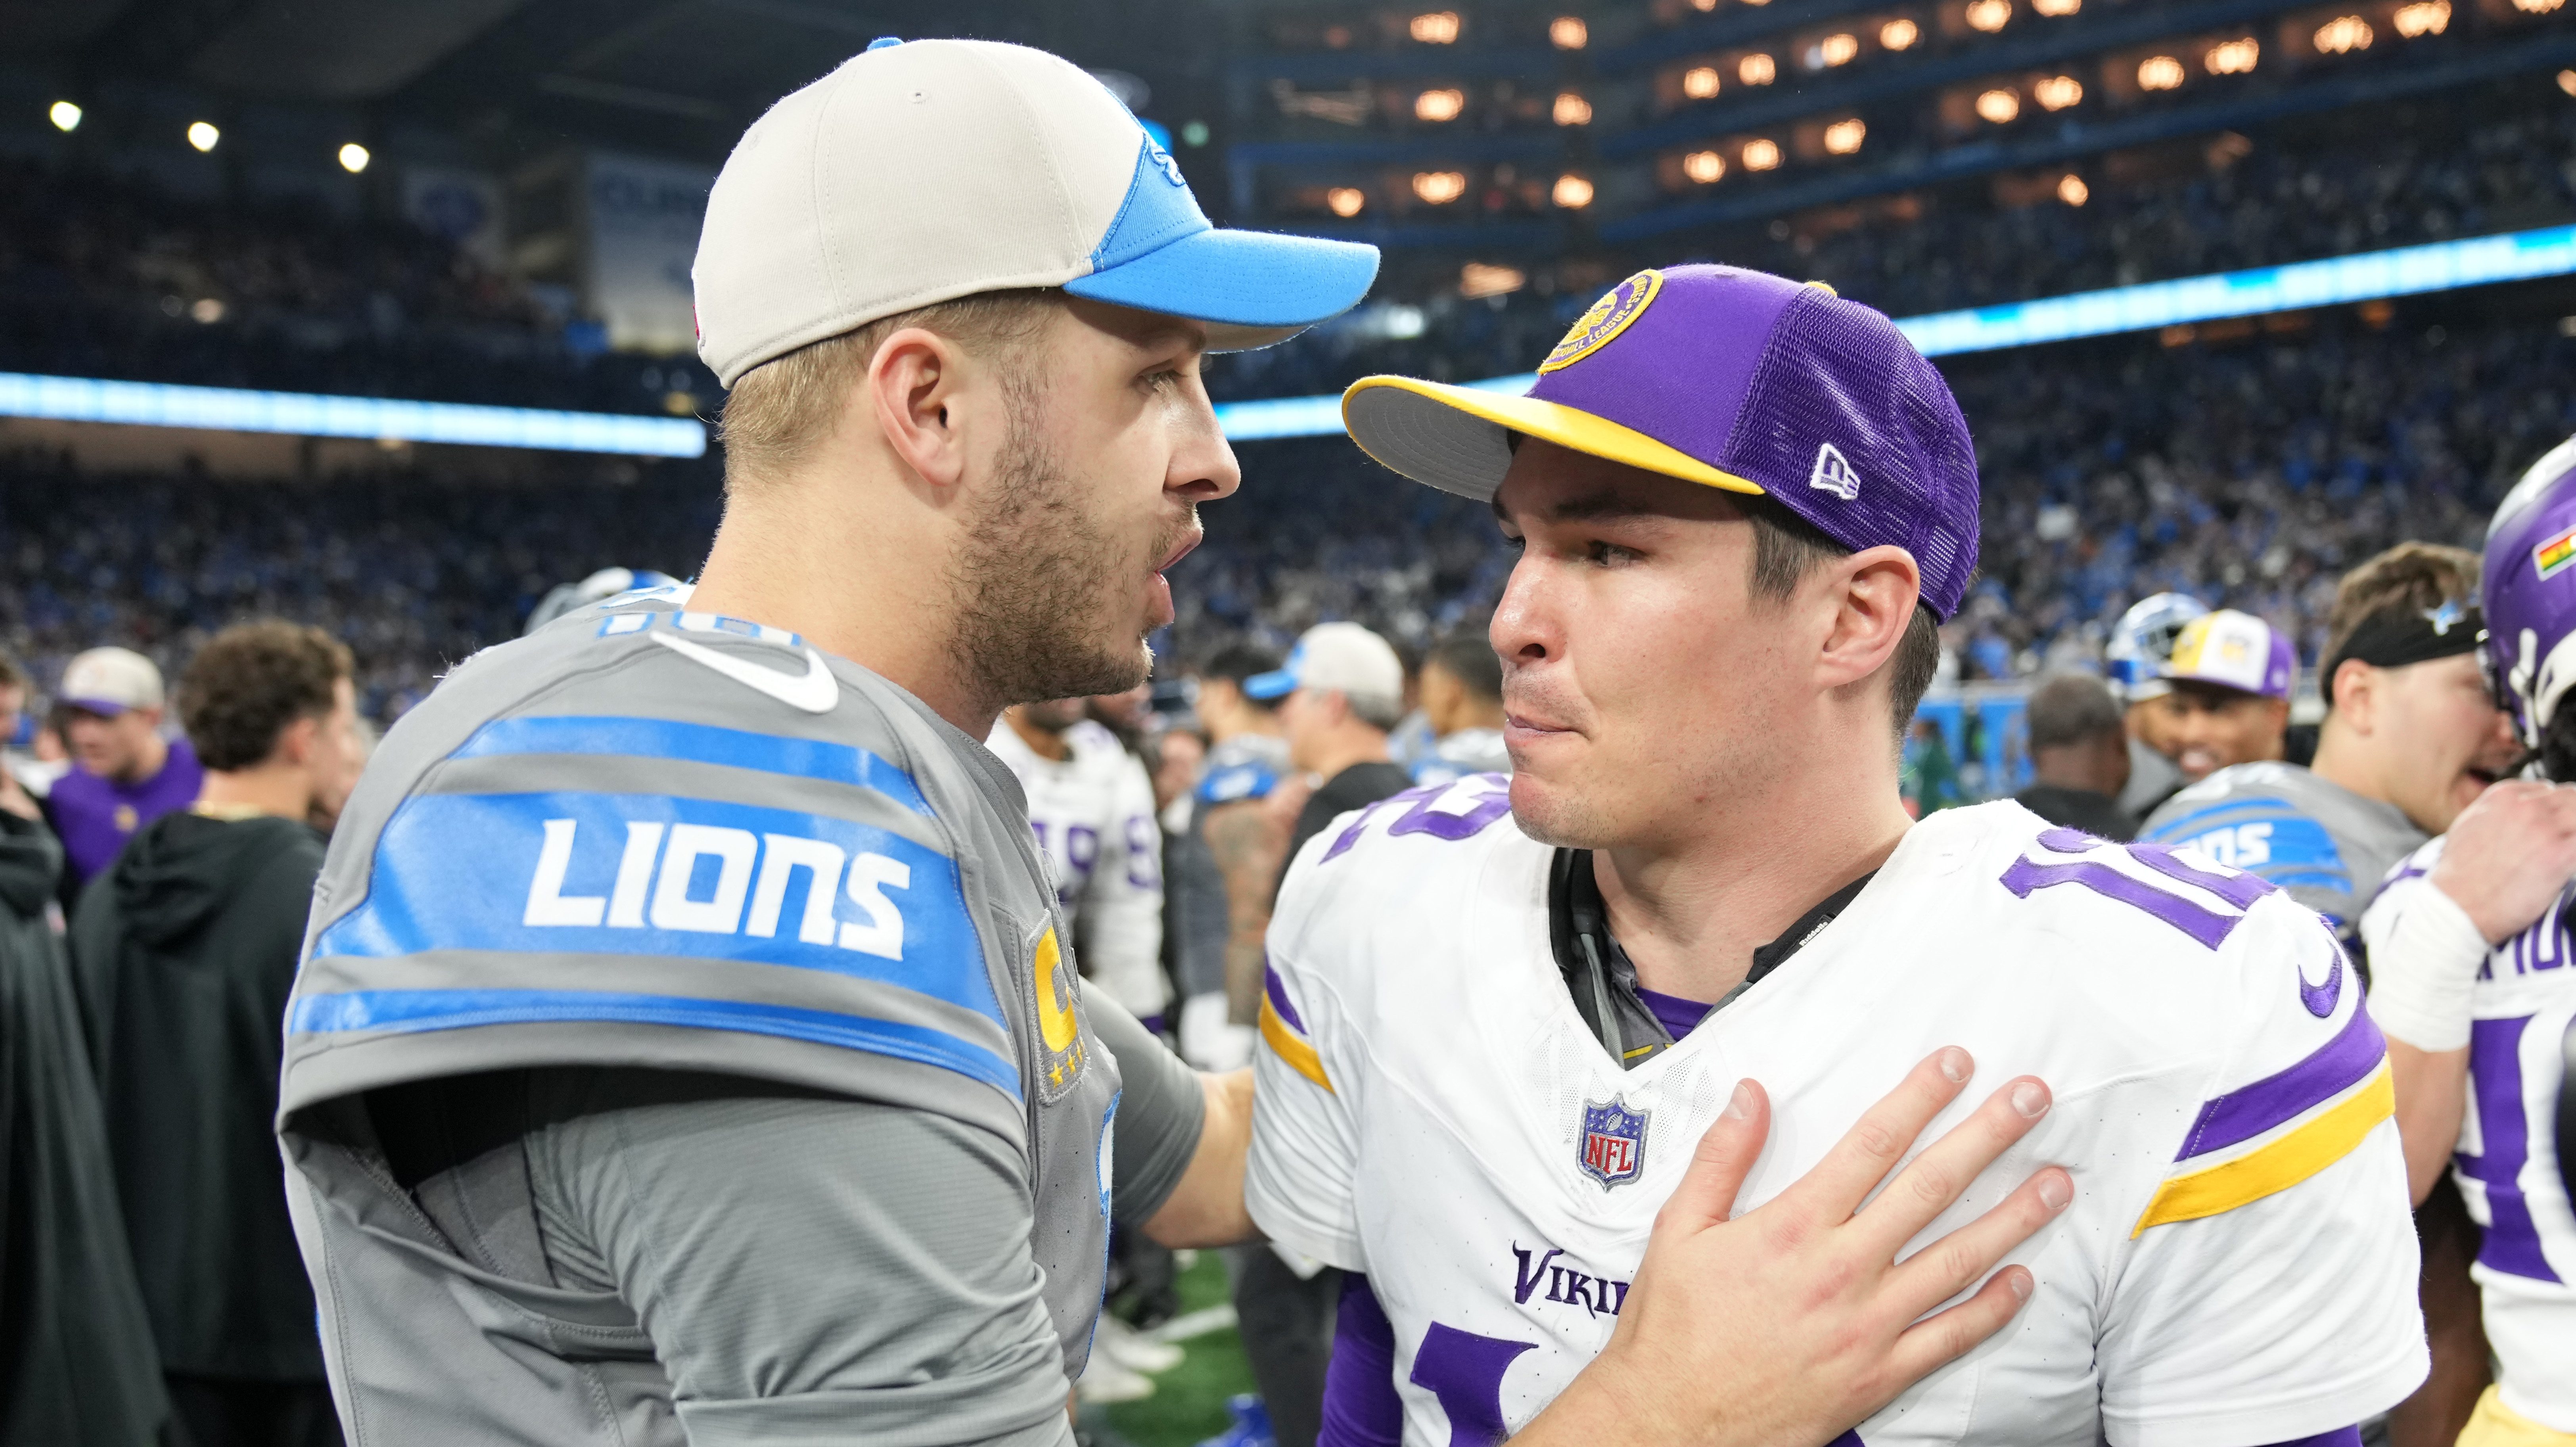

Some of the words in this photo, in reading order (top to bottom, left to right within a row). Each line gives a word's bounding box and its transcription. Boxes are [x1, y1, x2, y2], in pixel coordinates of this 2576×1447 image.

[1589, 309, 1630, 344] LEAGUE
[2184, 822, 2274, 867] NS
[523, 819, 911, 961] LIONS
[1586, 1134, 1633, 1174] NFL
